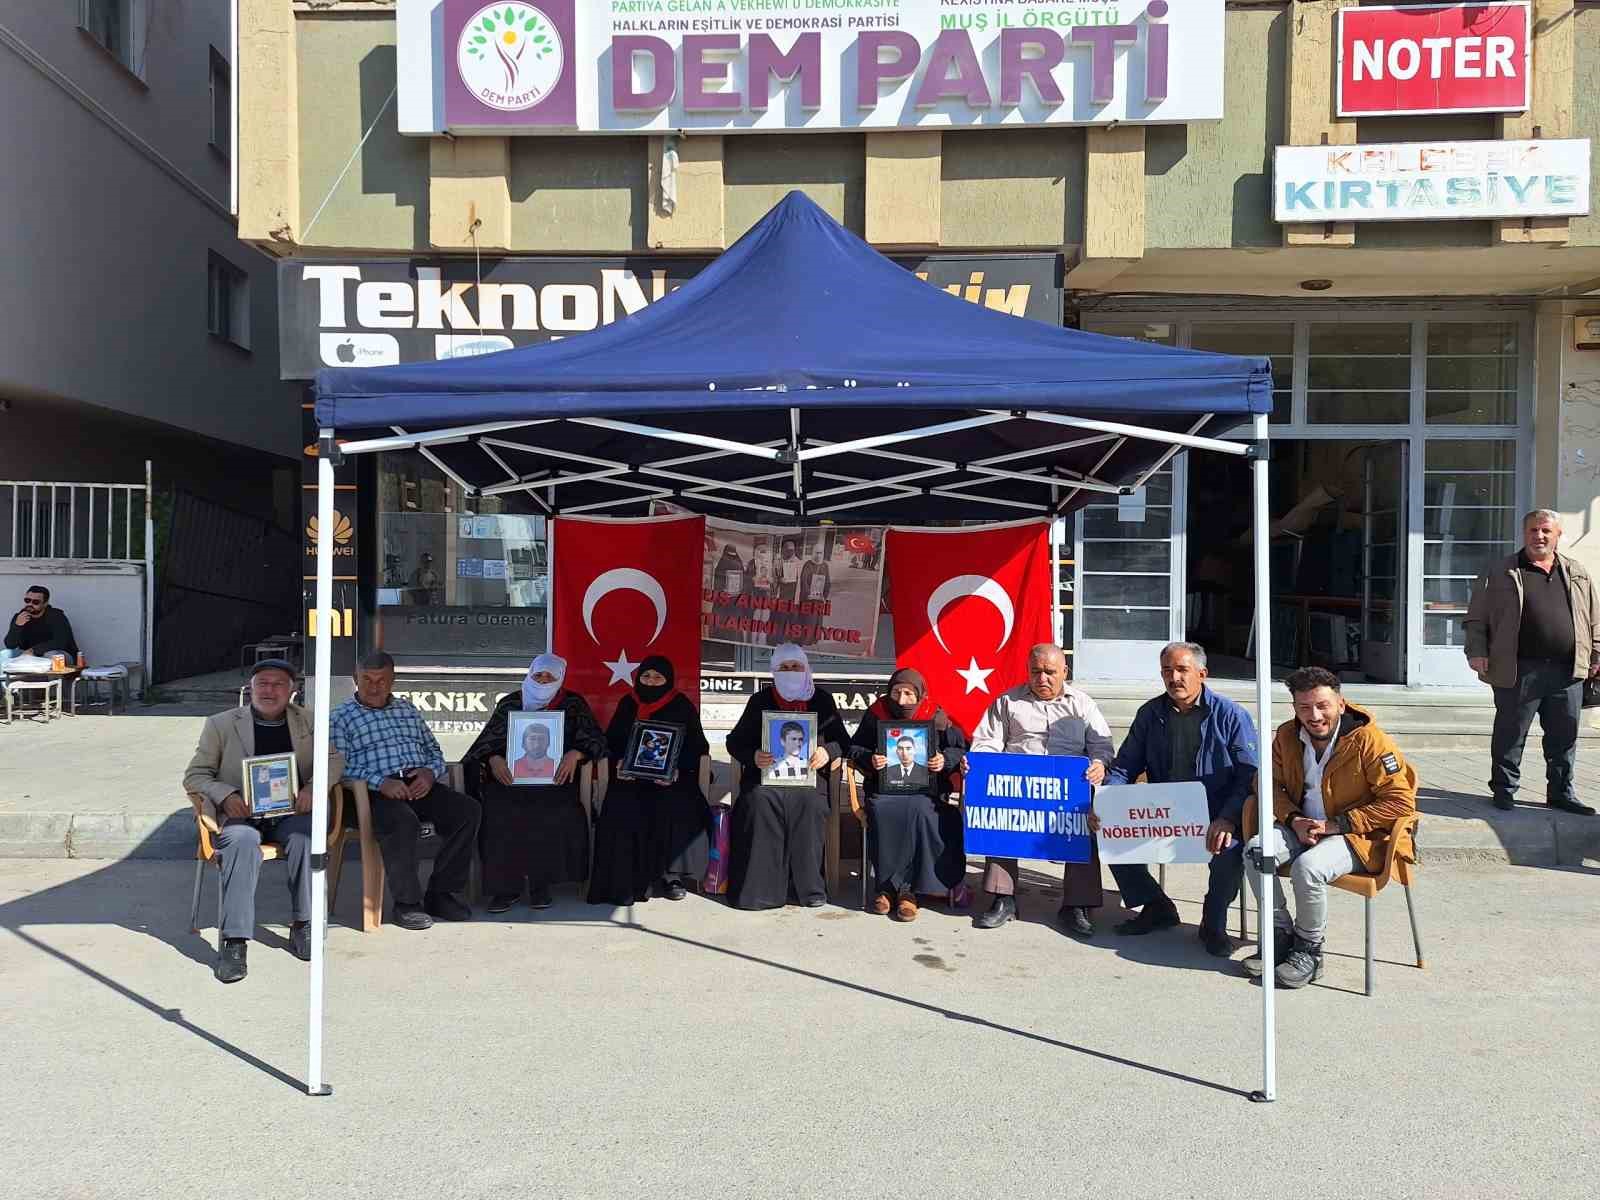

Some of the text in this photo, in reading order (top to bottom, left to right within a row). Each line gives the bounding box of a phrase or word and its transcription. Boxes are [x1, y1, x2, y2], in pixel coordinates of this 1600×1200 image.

[612, 13, 900, 32] HALKLARIN EŞİTLİK VE DEMOKRASİ PARTİSİ
[940, 7, 1120, 32] MUŞ İL ÖRGÜTÜ
[612, 0, 1169, 112] DEM PARTİ
[1352, 36, 1517, 81] NOTER
[481, 88, 505, 104] DEM
[1284, 172, 1579, 210] KIRTASİYE
[306, 546, 354, 556] HWEI
[987, 774, 1069, 800] ARTIK YETER !
[966, 806, 1045, 833] YAKAMIZDAN
[1129, 807, 1171, 820] EVLAT
[1102, 823, 1205, 839] NÖBETİNDEYİZ
